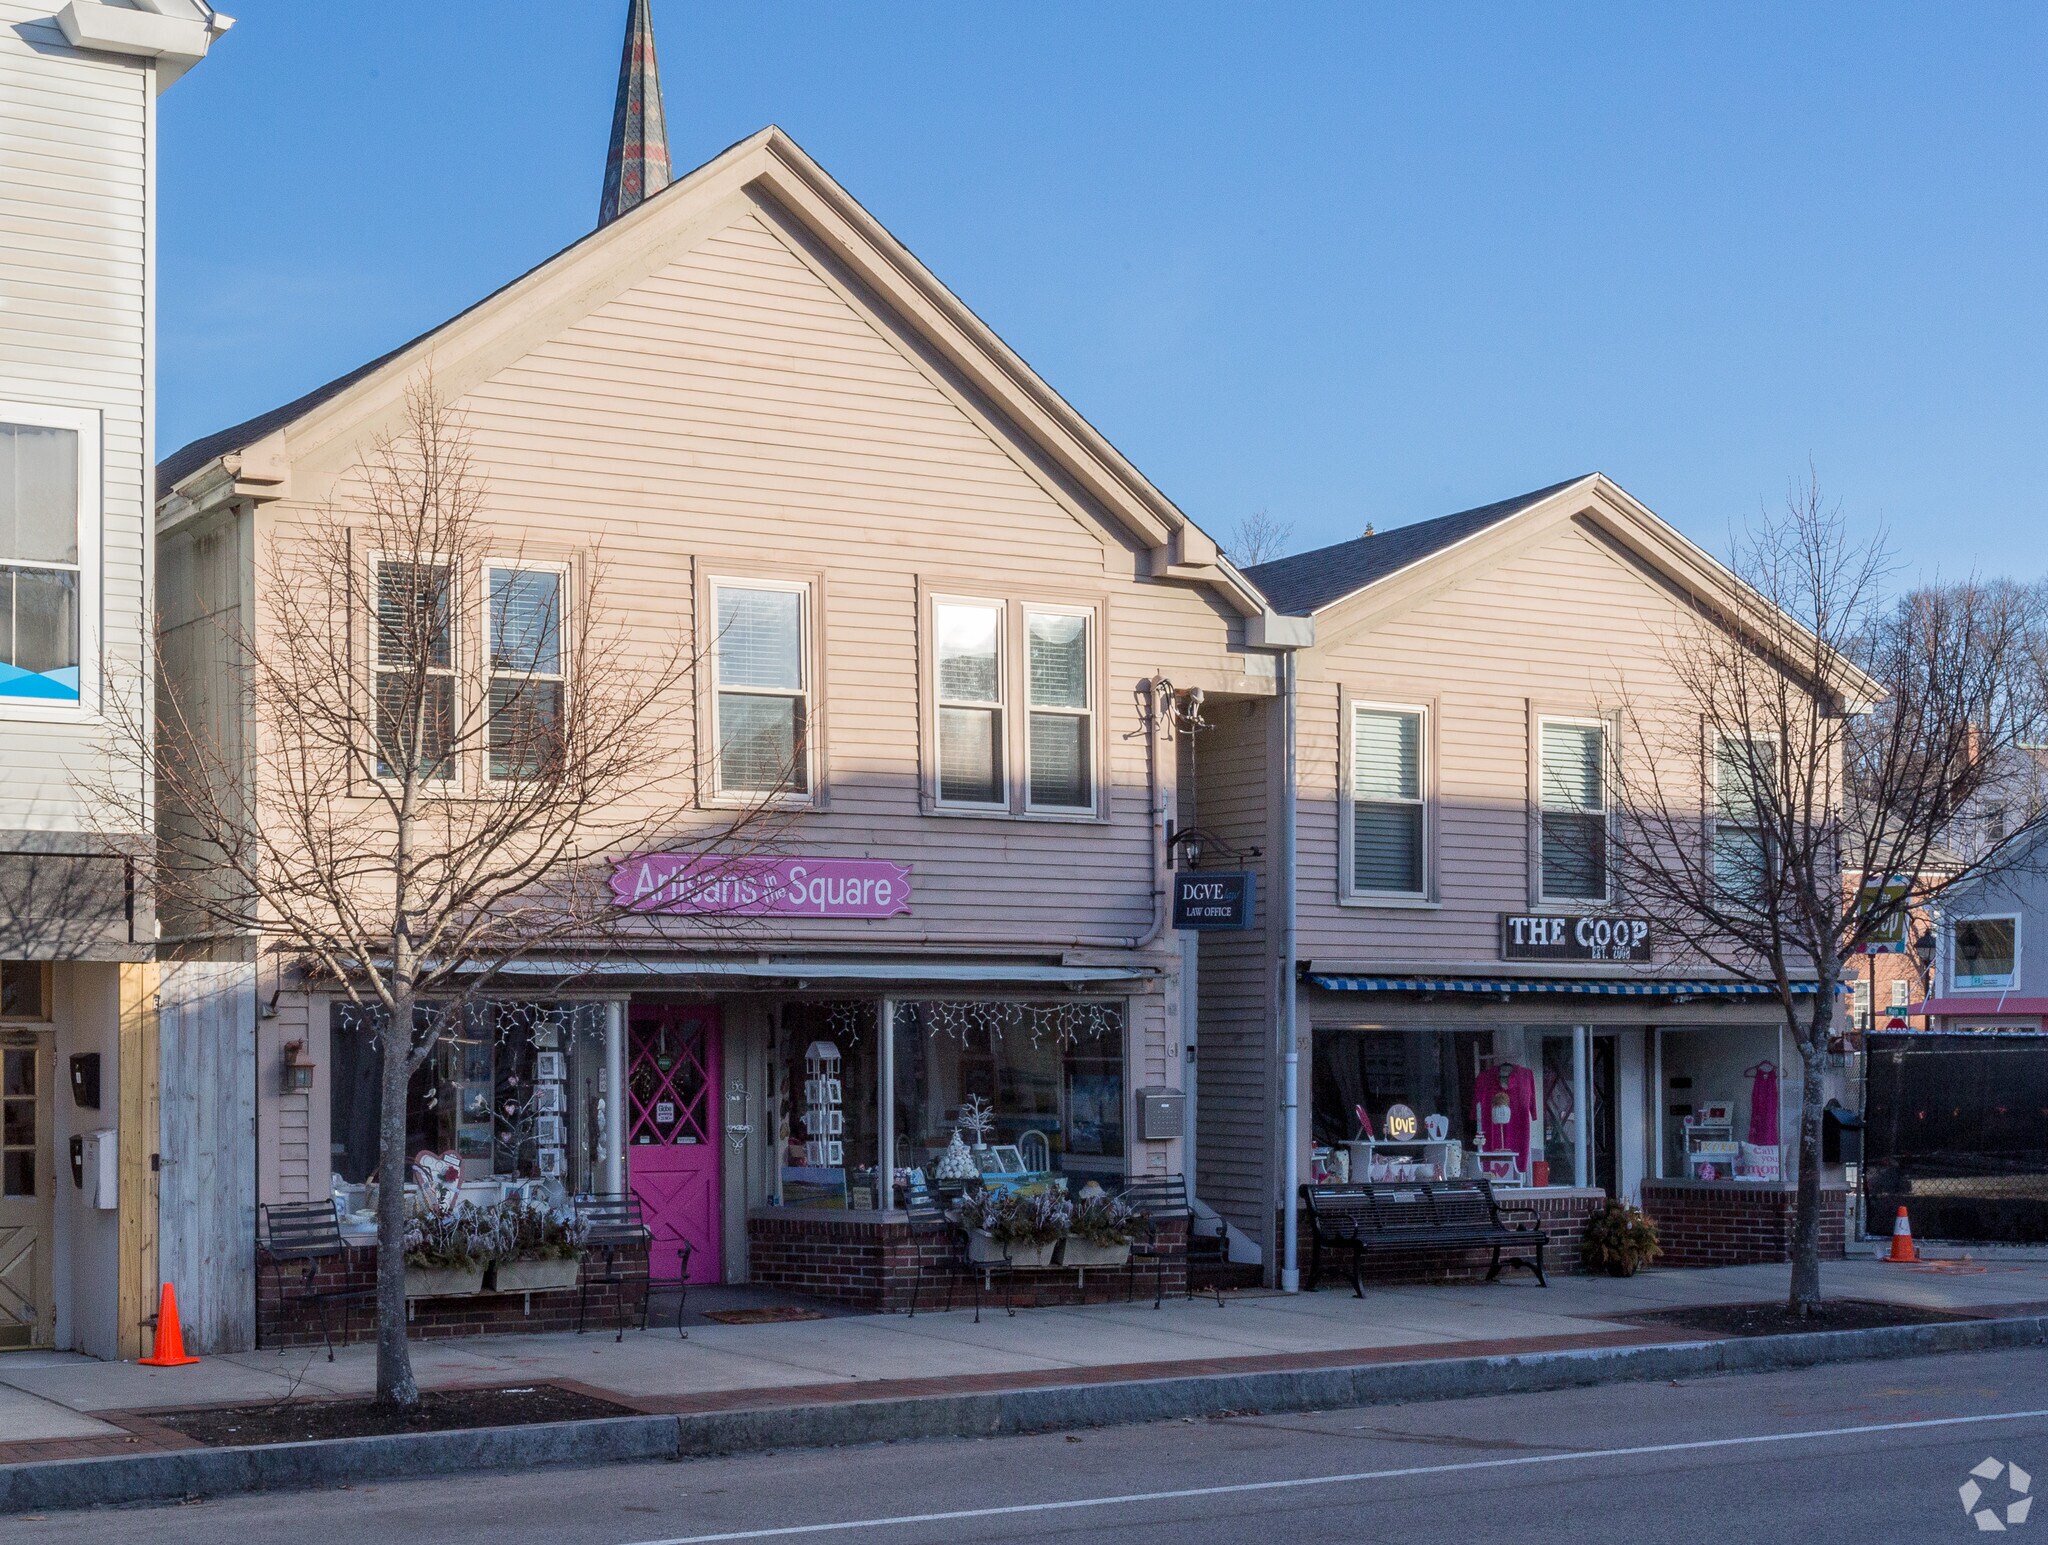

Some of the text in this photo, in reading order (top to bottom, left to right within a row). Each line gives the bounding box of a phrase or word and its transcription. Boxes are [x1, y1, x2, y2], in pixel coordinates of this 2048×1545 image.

[634, 862, 892, 912] Artisans in the Square
[1182, 883, 1224, 900] DGVE
[1186, 906, 1232, 917] LAW OFFICE
[1508, 917, 1648, 948] THE COOP
[1390, 1116, 1416, 1136] LOVE
[1752, 1146, 1774, 1155] Call
